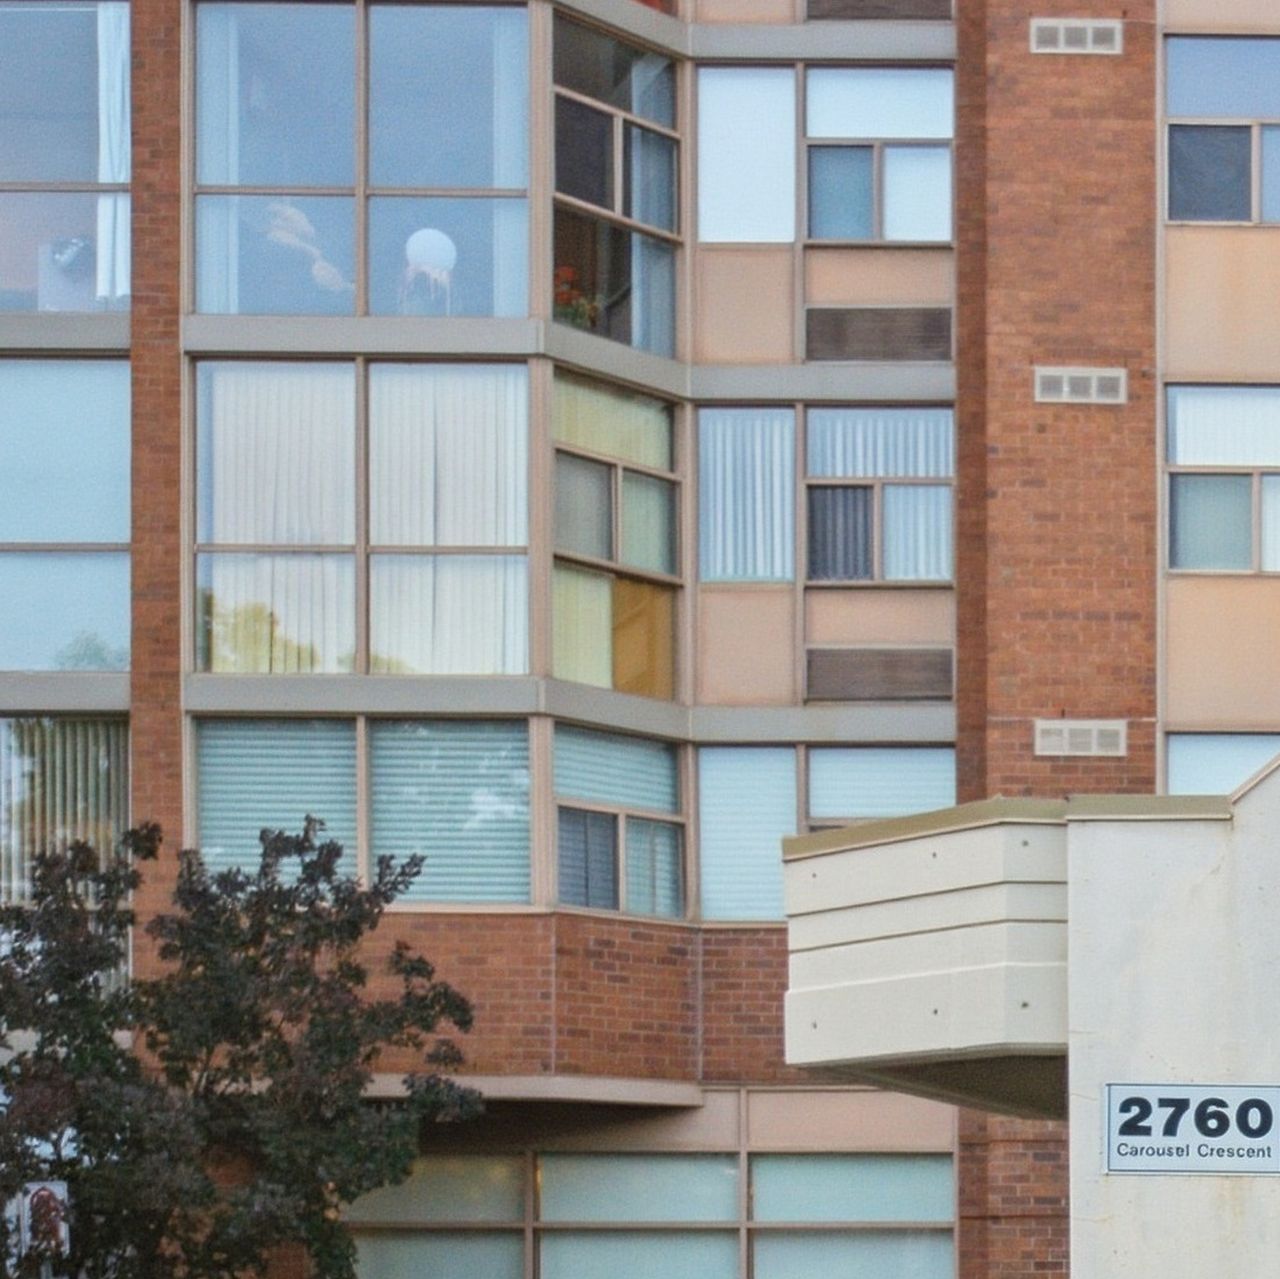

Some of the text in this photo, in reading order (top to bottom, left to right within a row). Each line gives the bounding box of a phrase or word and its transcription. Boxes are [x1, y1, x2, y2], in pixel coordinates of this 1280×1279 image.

[1118, 1096, 1273, 1139] 2760
[1116, 1142, 1272, 1158] Carousel Crescent
